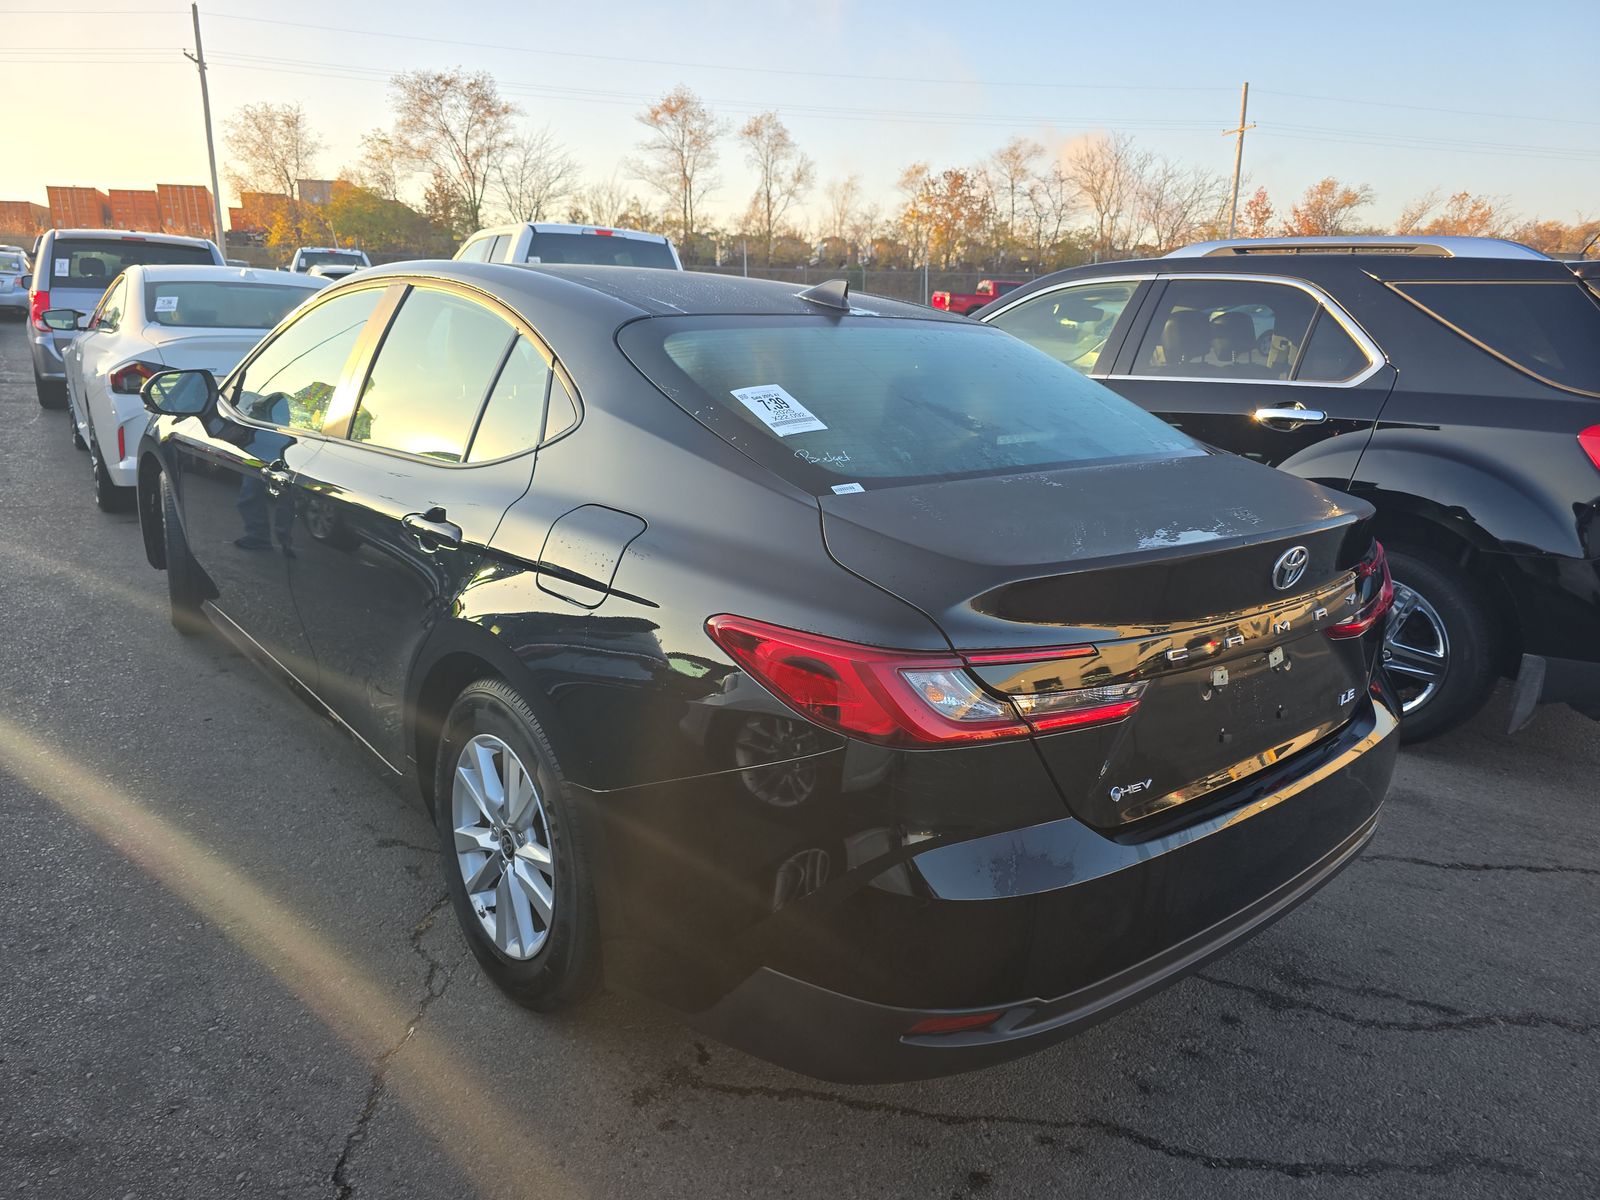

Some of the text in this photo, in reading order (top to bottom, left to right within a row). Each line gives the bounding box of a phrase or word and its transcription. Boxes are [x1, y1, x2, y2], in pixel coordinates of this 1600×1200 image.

[756, 397, 790, 411] 7:39
[1338, 688, 1356, 707] LE
[1120, 778, 1153, 797] HEV
